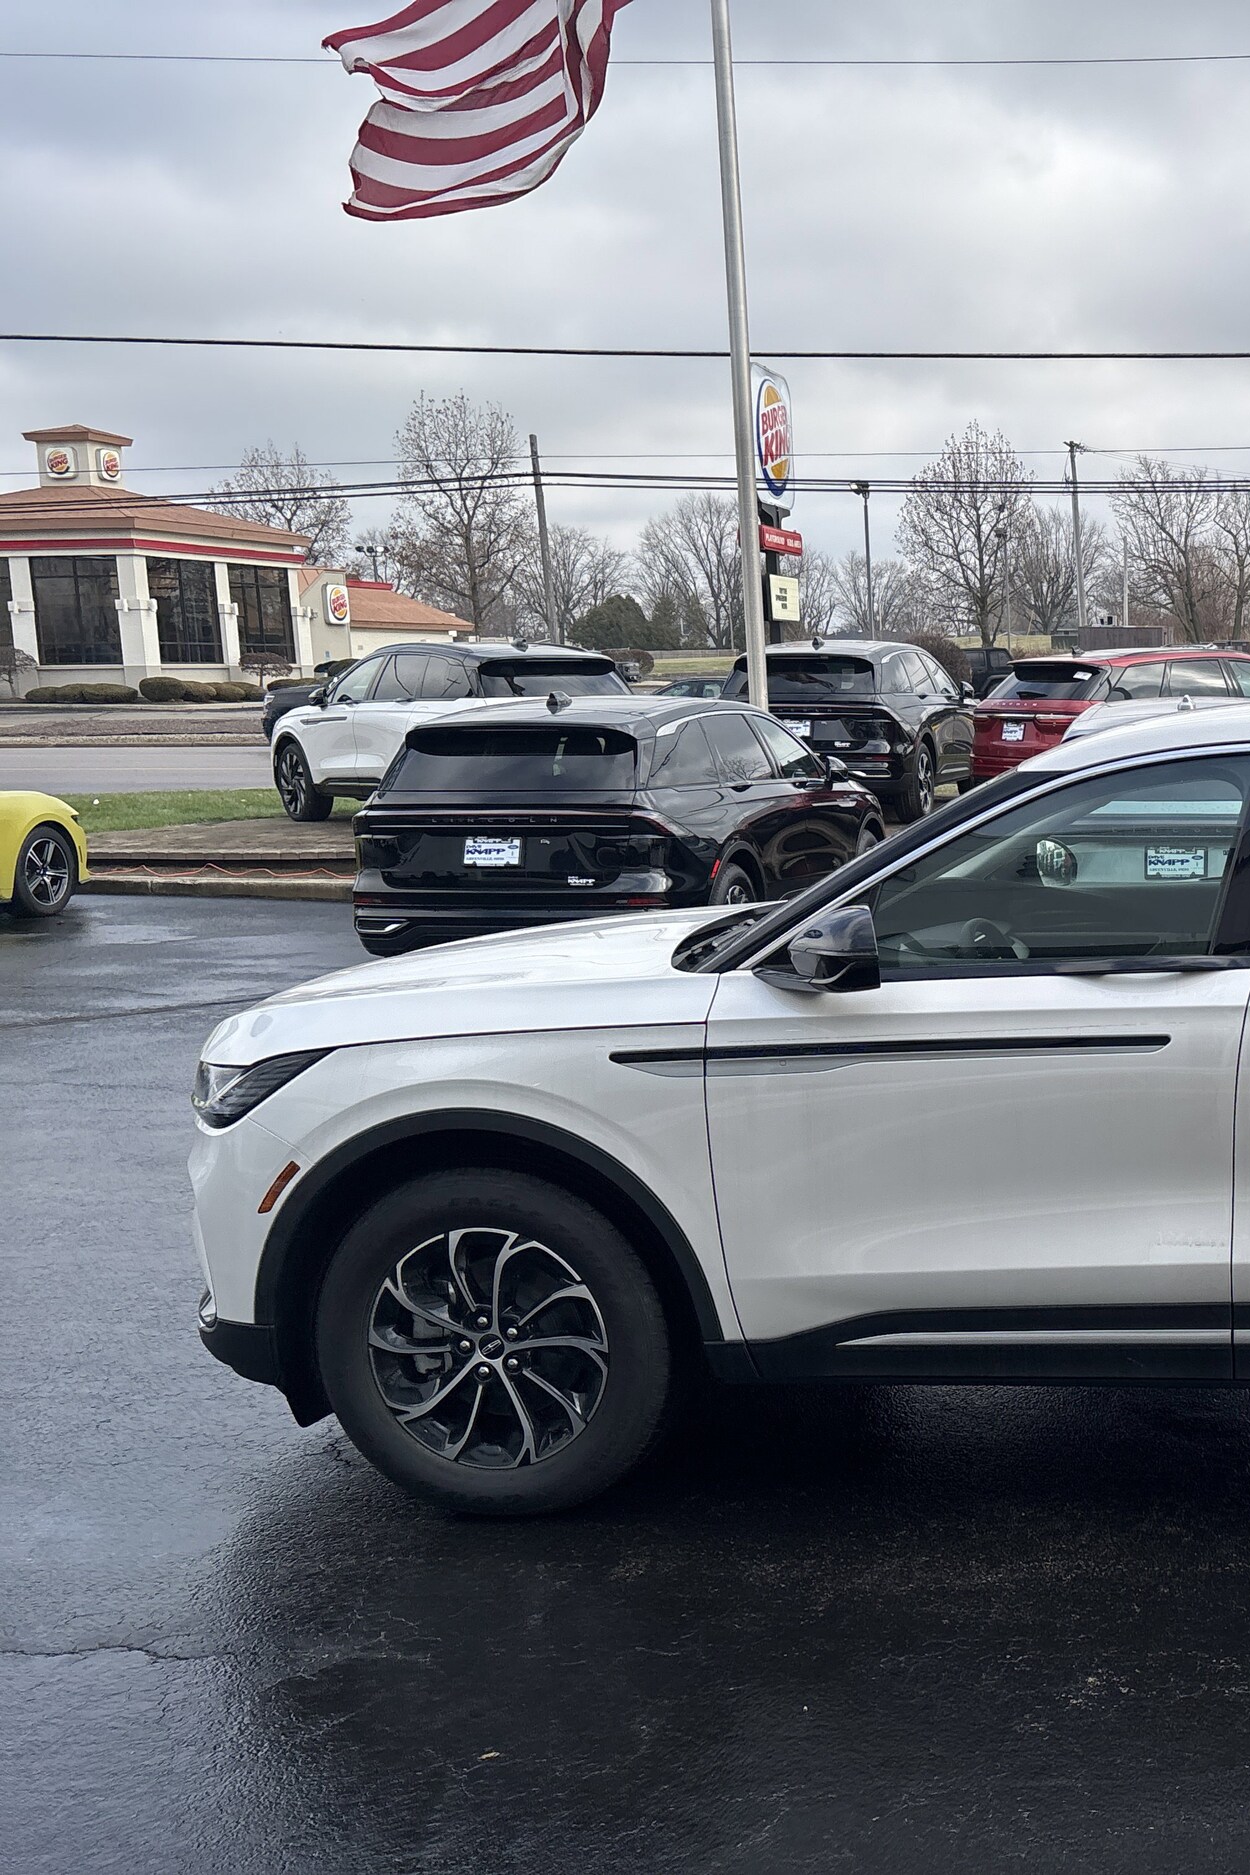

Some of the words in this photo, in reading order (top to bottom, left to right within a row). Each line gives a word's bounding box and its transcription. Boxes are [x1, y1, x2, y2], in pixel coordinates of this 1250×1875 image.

[763, 424, 791, 467] KING
[50, 457, 68, 469] KING
[333, 600, 347, 613] KING
